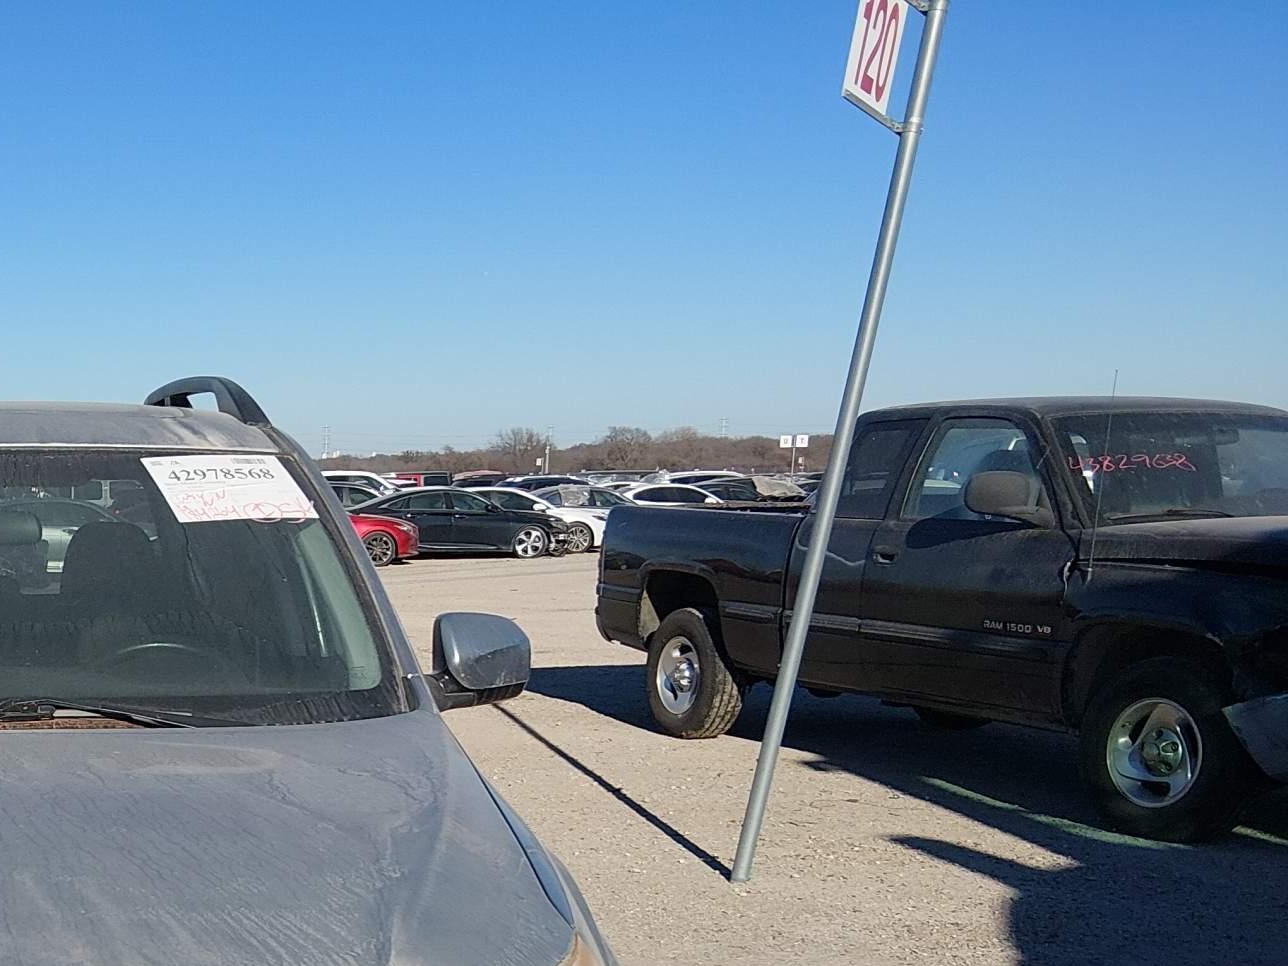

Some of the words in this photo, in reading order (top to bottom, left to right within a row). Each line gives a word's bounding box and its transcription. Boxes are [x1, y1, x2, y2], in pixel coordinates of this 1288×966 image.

[855, 0, 900, 102] 120
[168, 467, 275, 481] 42978568
[983, 619, 1004, 630] RAM
[1006, 623, 1032, 633] 1500
